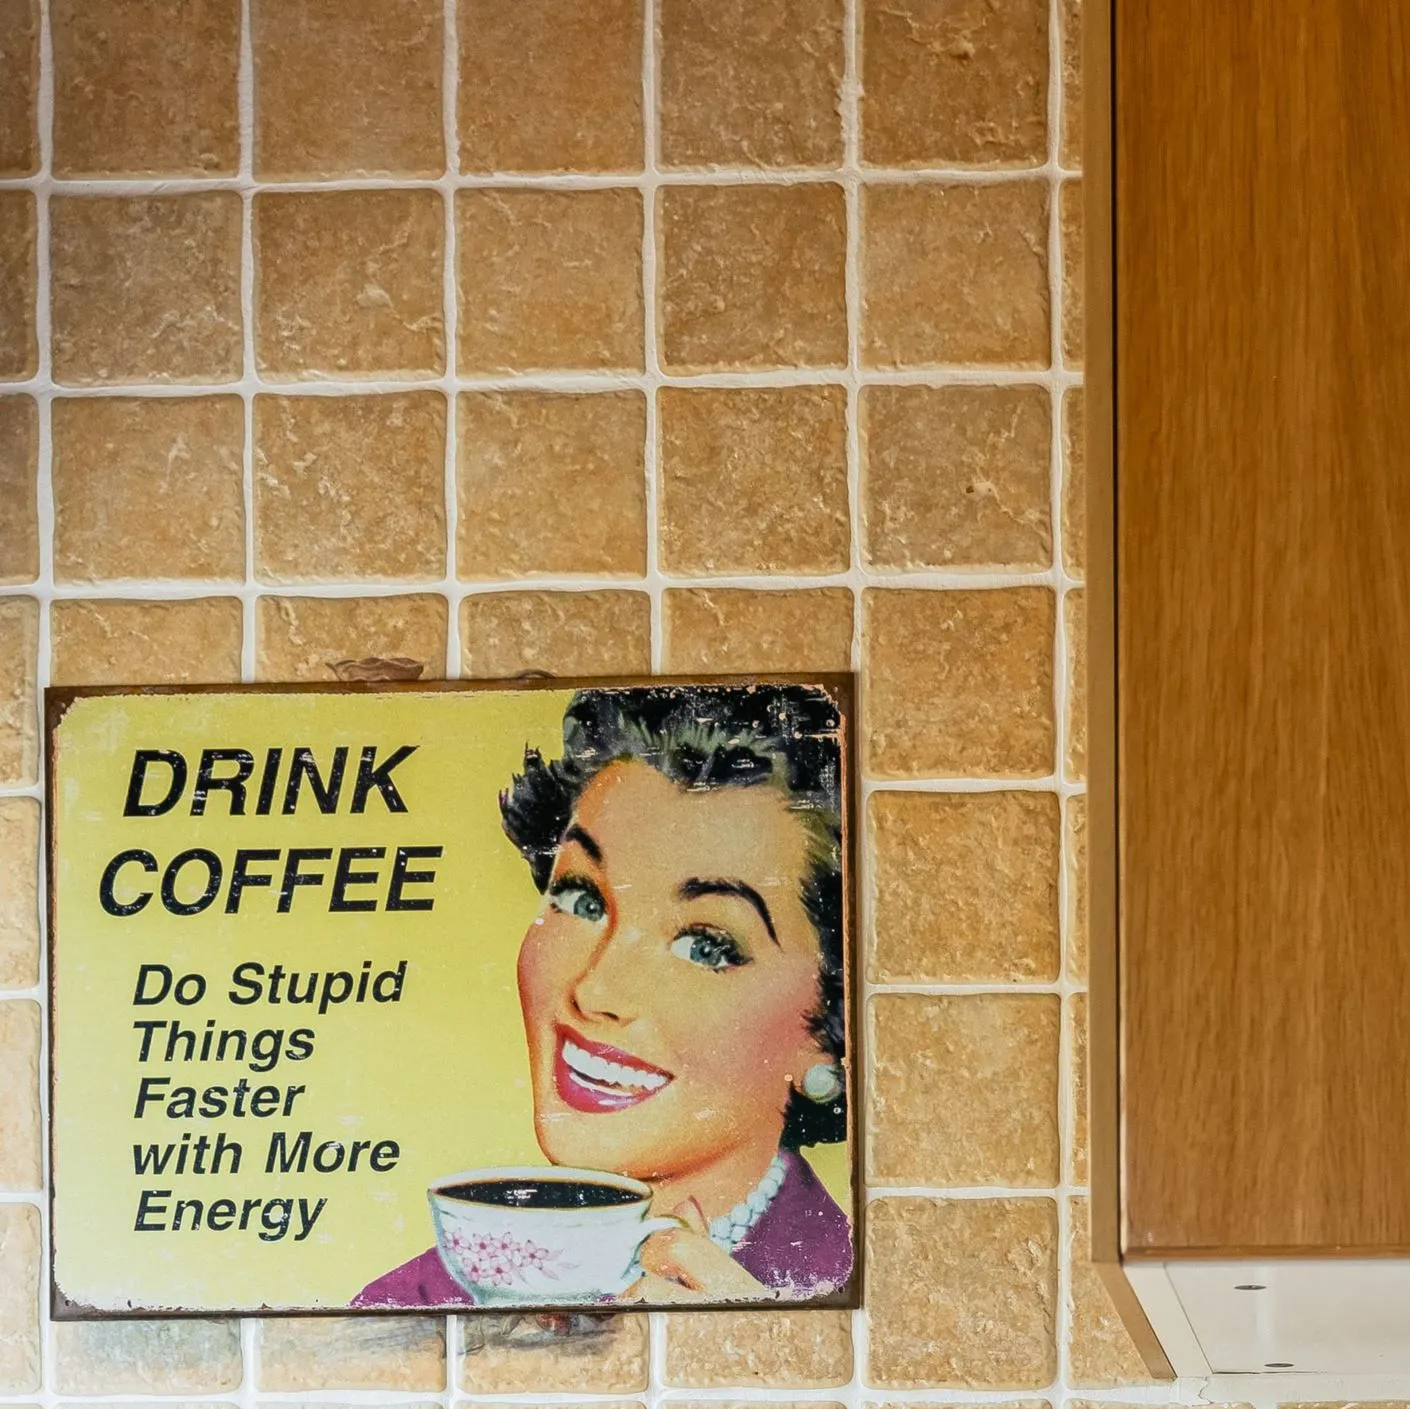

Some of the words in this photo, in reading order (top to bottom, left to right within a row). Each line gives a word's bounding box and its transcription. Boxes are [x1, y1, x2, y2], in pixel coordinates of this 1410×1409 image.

[122, 745, 420, 817] DRINK
[99, 845, 444, 917] COFFEE
[132, 964, 207, 1006] Do
[228, 960, 408, 1015] Stupid
[133, 1020, 315, 1073] Things
[134, 1077, 306, 1119] Faster
[133, 1132, 242, 1175] with
[265, 1131, 400, 1173] More
[134, 1190, 327, 1242] Energy
